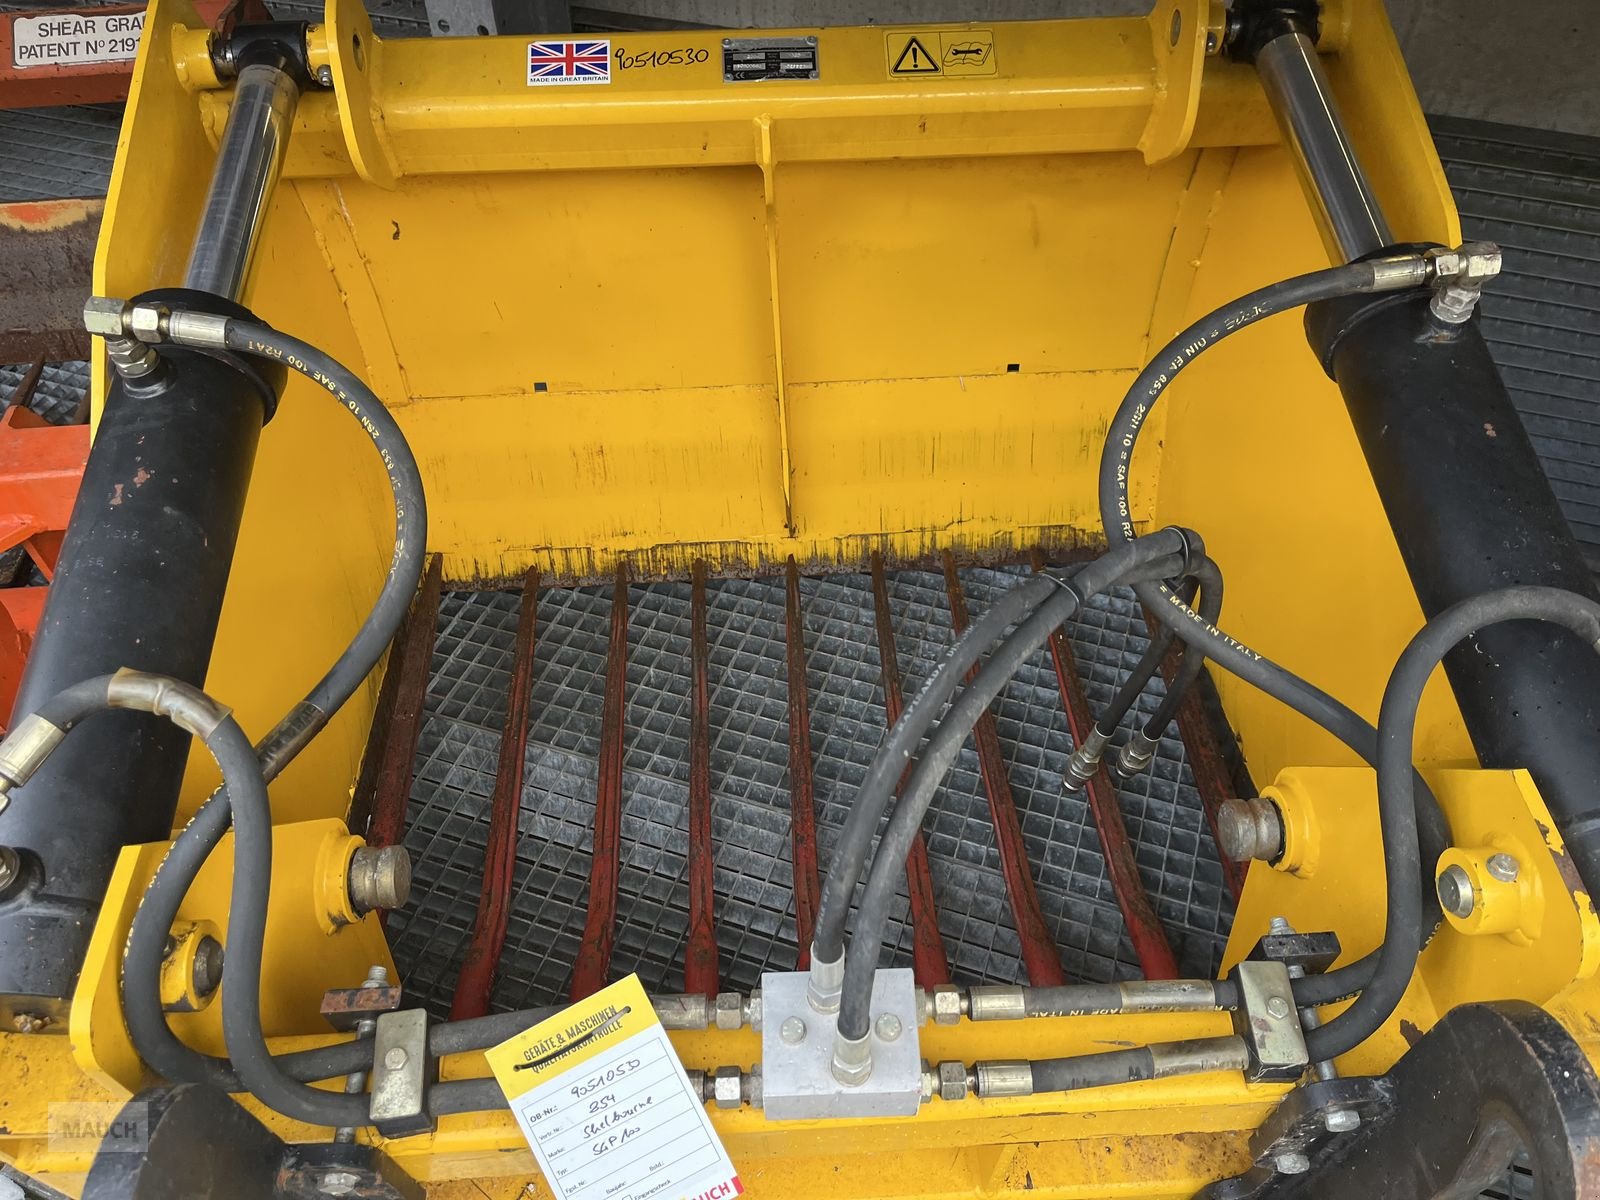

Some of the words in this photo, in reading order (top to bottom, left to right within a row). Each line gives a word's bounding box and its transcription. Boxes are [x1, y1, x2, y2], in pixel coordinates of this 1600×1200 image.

[38, 20, 96, 37] SHEAR
[19, 41, 80, 60] PATENT
[614, 48, 709, 71] 90510530
[1185, 337, 1207, 357] DIN
[287, 355, 308, 371] 100
[313, 370, 336, 391] SAE
[349, 401, 360, 415] 10
[1122, 433, 1134, 447] 10
[1118, 495, 1127, 517] 100
[1169, 595, 1203, 623] MADE
[1206, 624, 1220, 637] IN
[1224, 636, 1262, 661] ITALY
[523, 1036, 556, 1062] GERÄTE
[565, 1005, 618, 1041] MASCHINEN
[571, 1059, 641, 1098] 90510530
